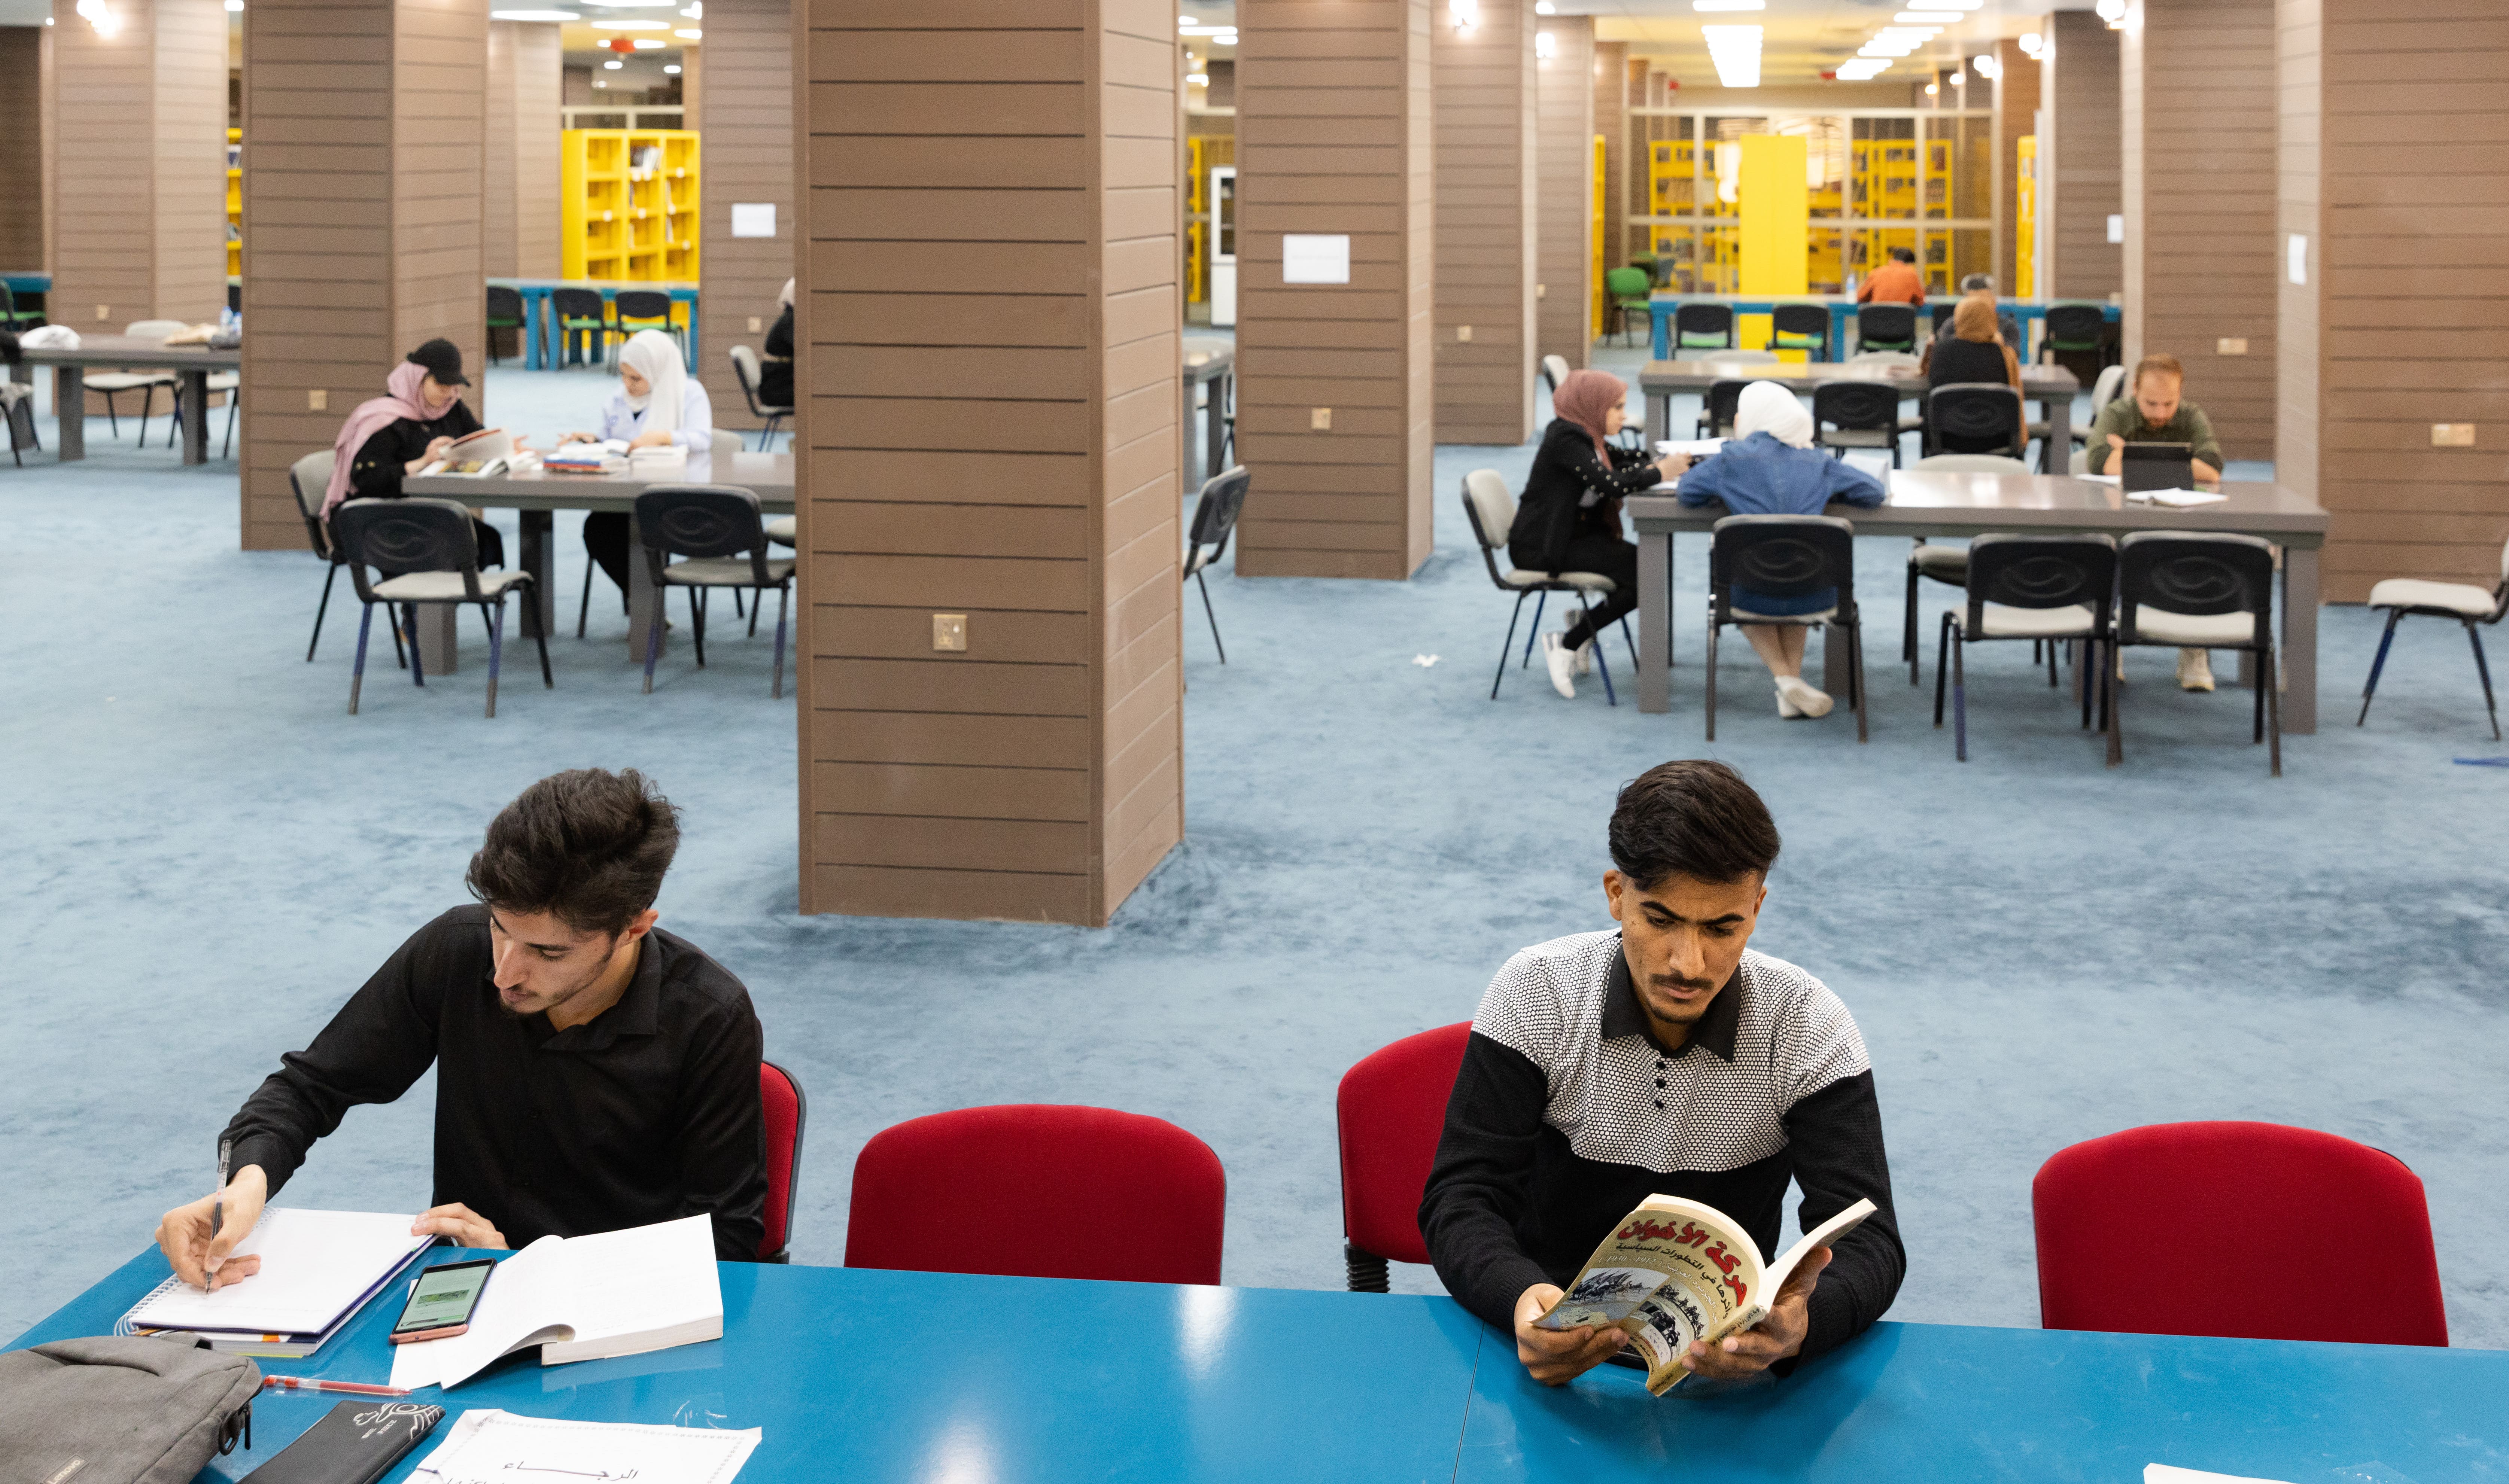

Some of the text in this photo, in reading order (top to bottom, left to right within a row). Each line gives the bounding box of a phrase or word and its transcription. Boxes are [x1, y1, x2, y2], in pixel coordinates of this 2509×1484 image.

[1616, 1242, 1662, 1252] السياسية
[1660, 1248, 1705, 1270] التطورات
[1700, 1271, 1717, 1285] في
[1705, 1241, 1747, 1307] حركة
[1693, 1280, 1716, 1309] الجزيرة
[377, 1420, 397, 1434] PIECE
[46, 1460, 81, 1484] Lenovo
